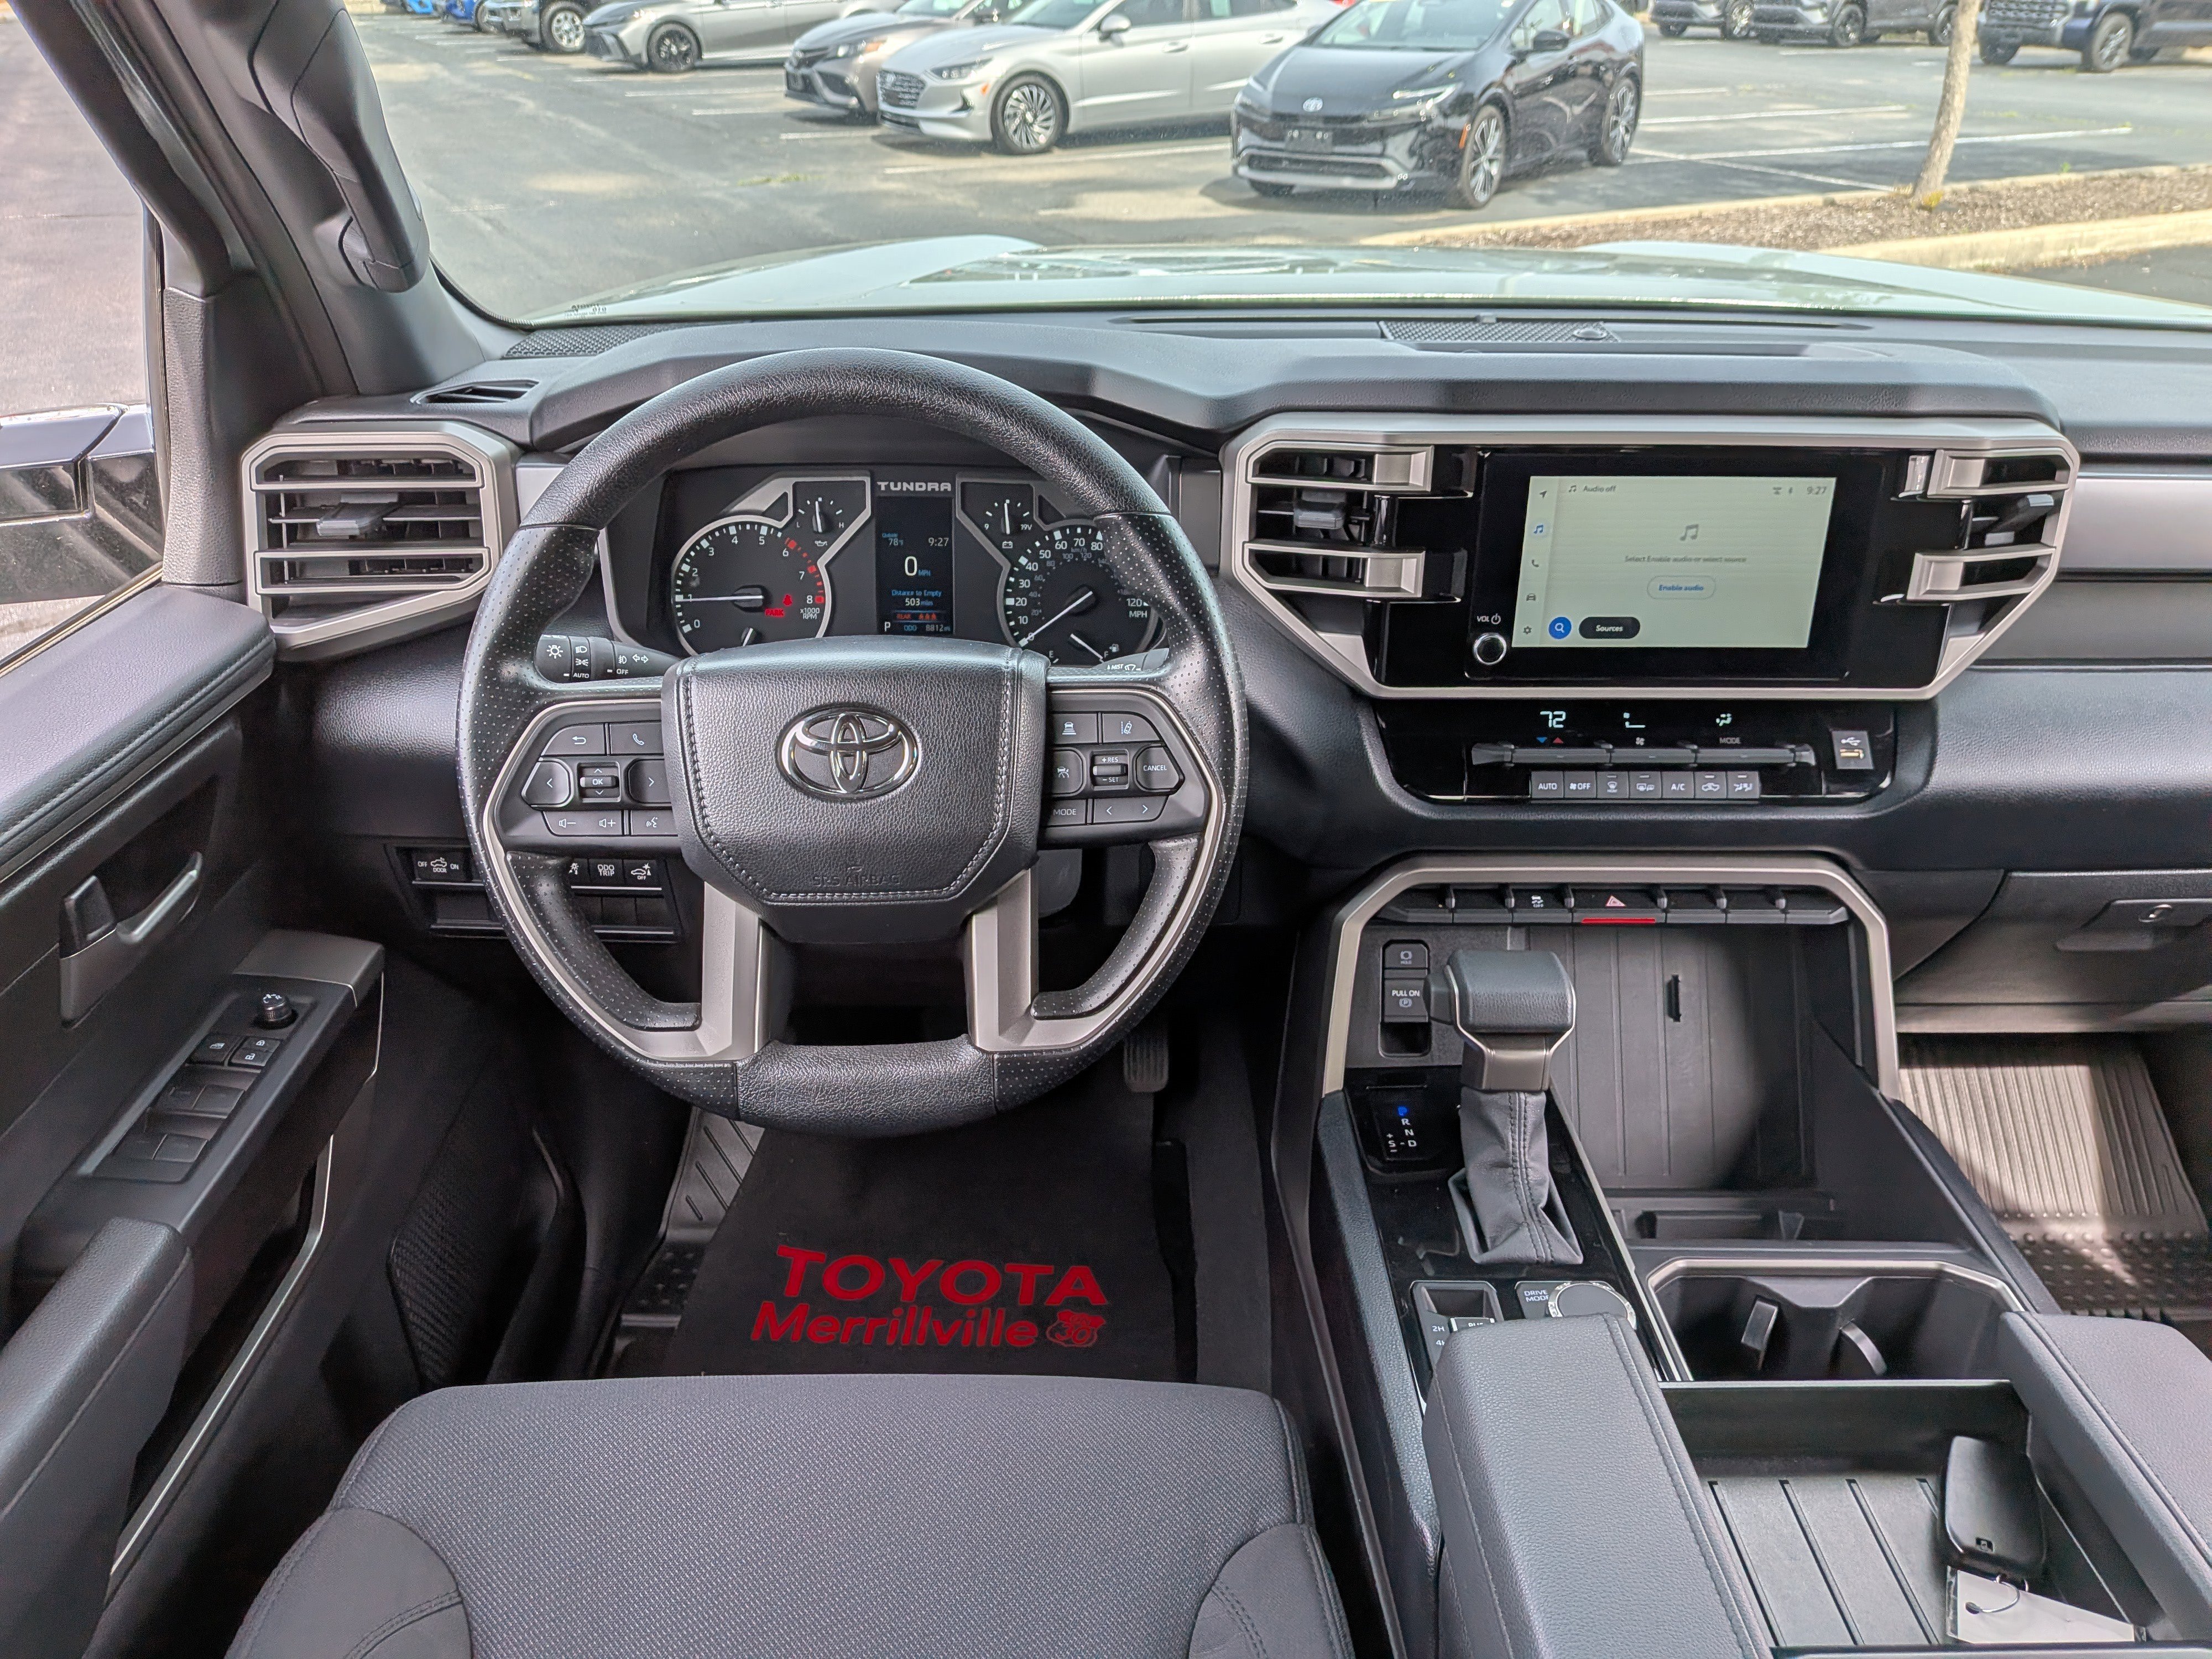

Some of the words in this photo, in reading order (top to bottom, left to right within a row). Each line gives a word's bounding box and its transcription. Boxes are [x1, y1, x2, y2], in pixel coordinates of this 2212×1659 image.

[877, 482, 951, 492] TUNDRA
[1806, 486, 1827, 495] 9:27
[731, 536, 738, 545] 4
[759, 536, 765, 545] 5
[928, 538, 949, 546] 9:27
[1073, 538, 1085, 546] 70
[1055, 541, 1067, 550] 60
[1091, 542, 1103, 551] 80
[708, 547, 714, 556] 3
[782, 548, 789, 557] 6
[1039, 550, 1051, 559] 50
[905, 556, 917, 576] 0
[1025, 562, 1038, 571] 40
[692, 568, 698, 577] 2
[799, 571, 805, 580] 7
[1019, 579, 1030, 588] 30
[807, 595, 813, 604] 8
[905, 598, 920, 606] 503
[1015, 597, 1027, 606] 20
[1126, 598, 1142, 607] 120
[765, 608, 784, 617] PARK
[693, 619, 700, 628] 0
[1018, 616, 1029, 625] 10
[885, 621, 891, 632] P
[1540, 711, 1566, 728] 72
[776, 1245, 1107, 1306] TOYOTA
[750, 1301, 1038, 1347] Merrillville
